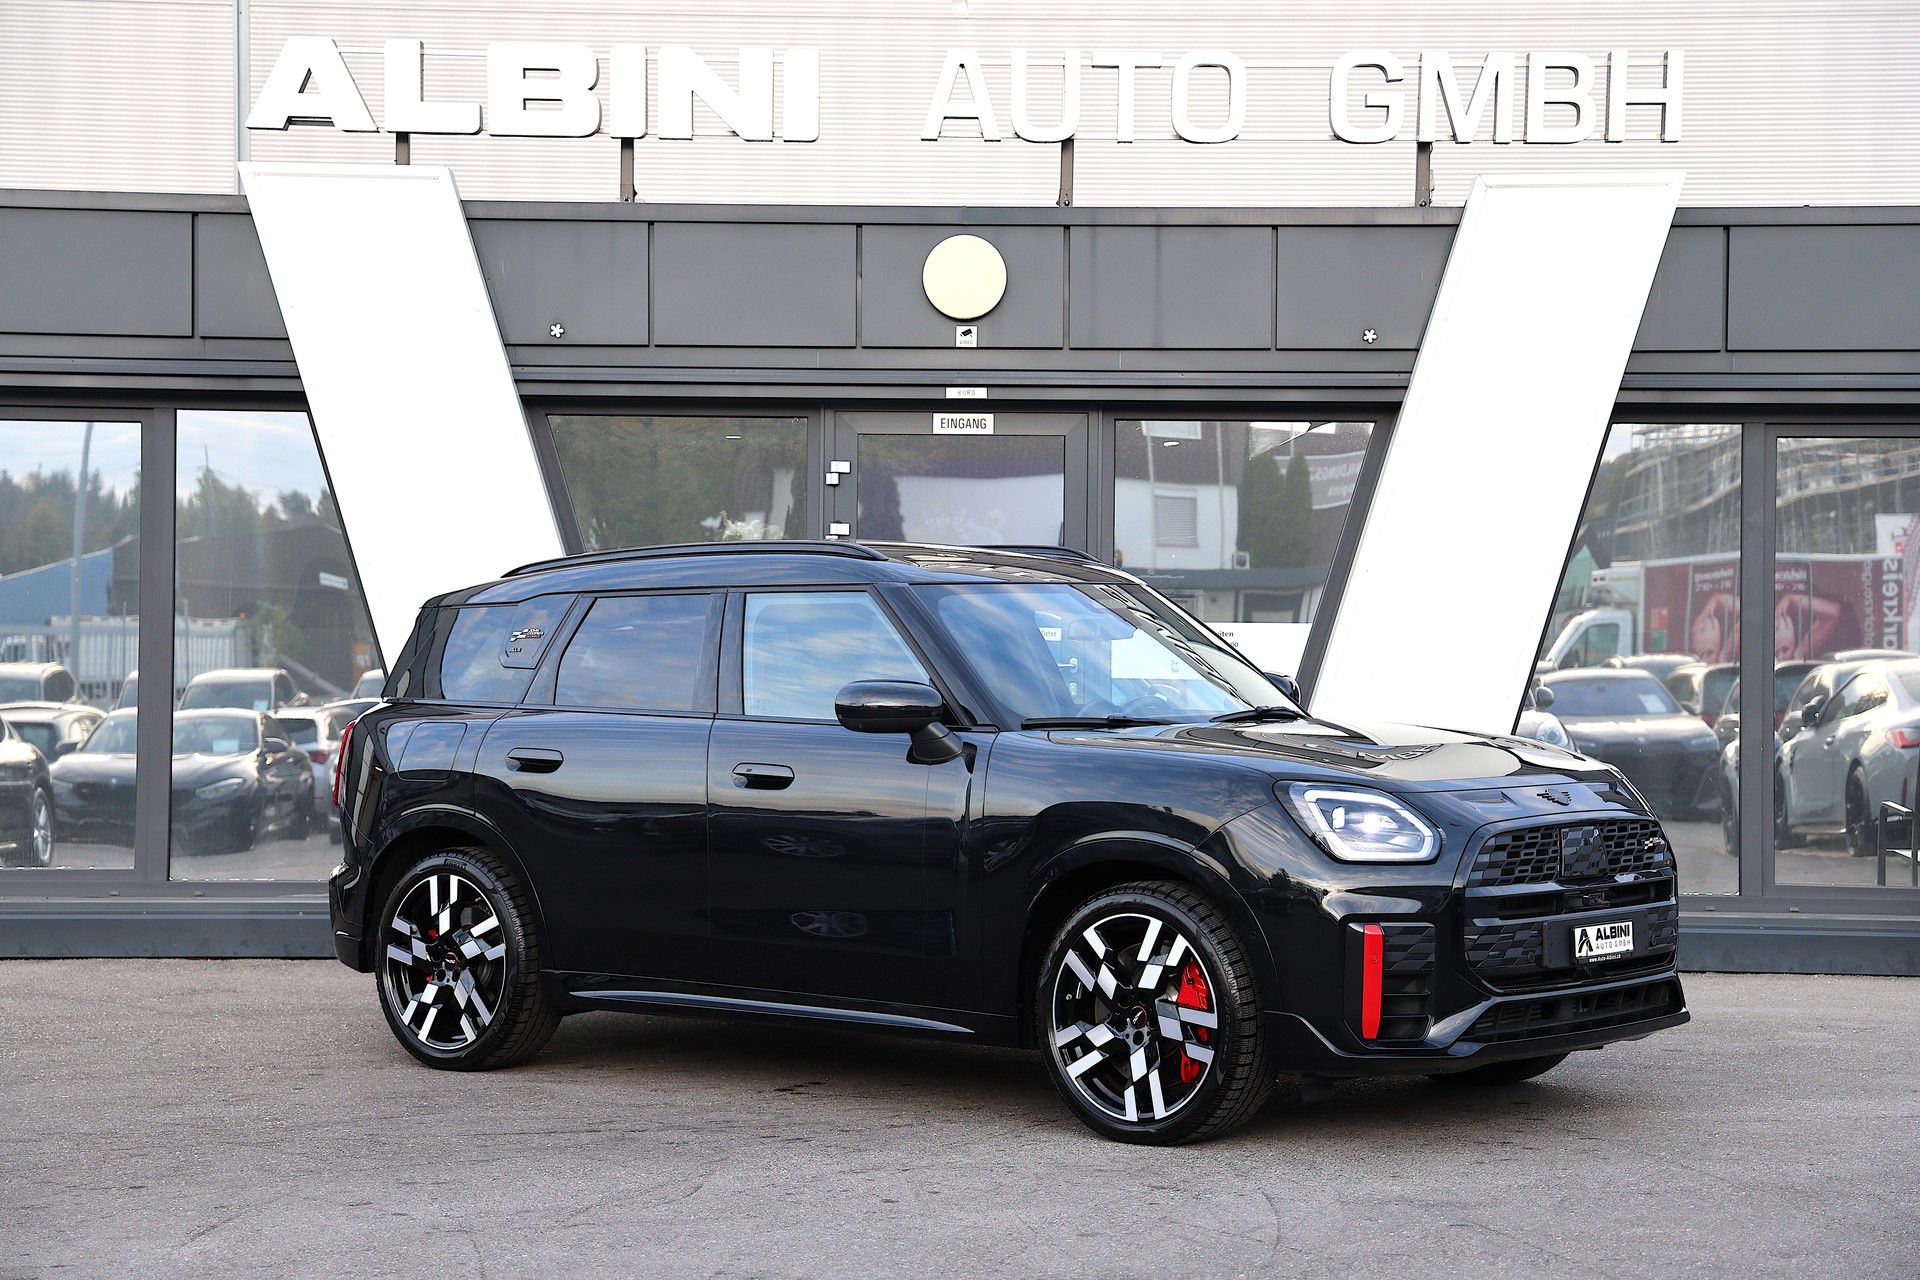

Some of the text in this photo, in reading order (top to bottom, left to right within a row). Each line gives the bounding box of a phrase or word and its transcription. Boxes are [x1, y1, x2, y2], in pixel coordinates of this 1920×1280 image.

[245, 36, 1685, 144] ALBINI AUTO GMBH
[940, 418, 987, 430] EINGANG
[1595, 923, 1630, 941] ALBINI
[1596, 939, 1631, 950] AUTO GMBH
